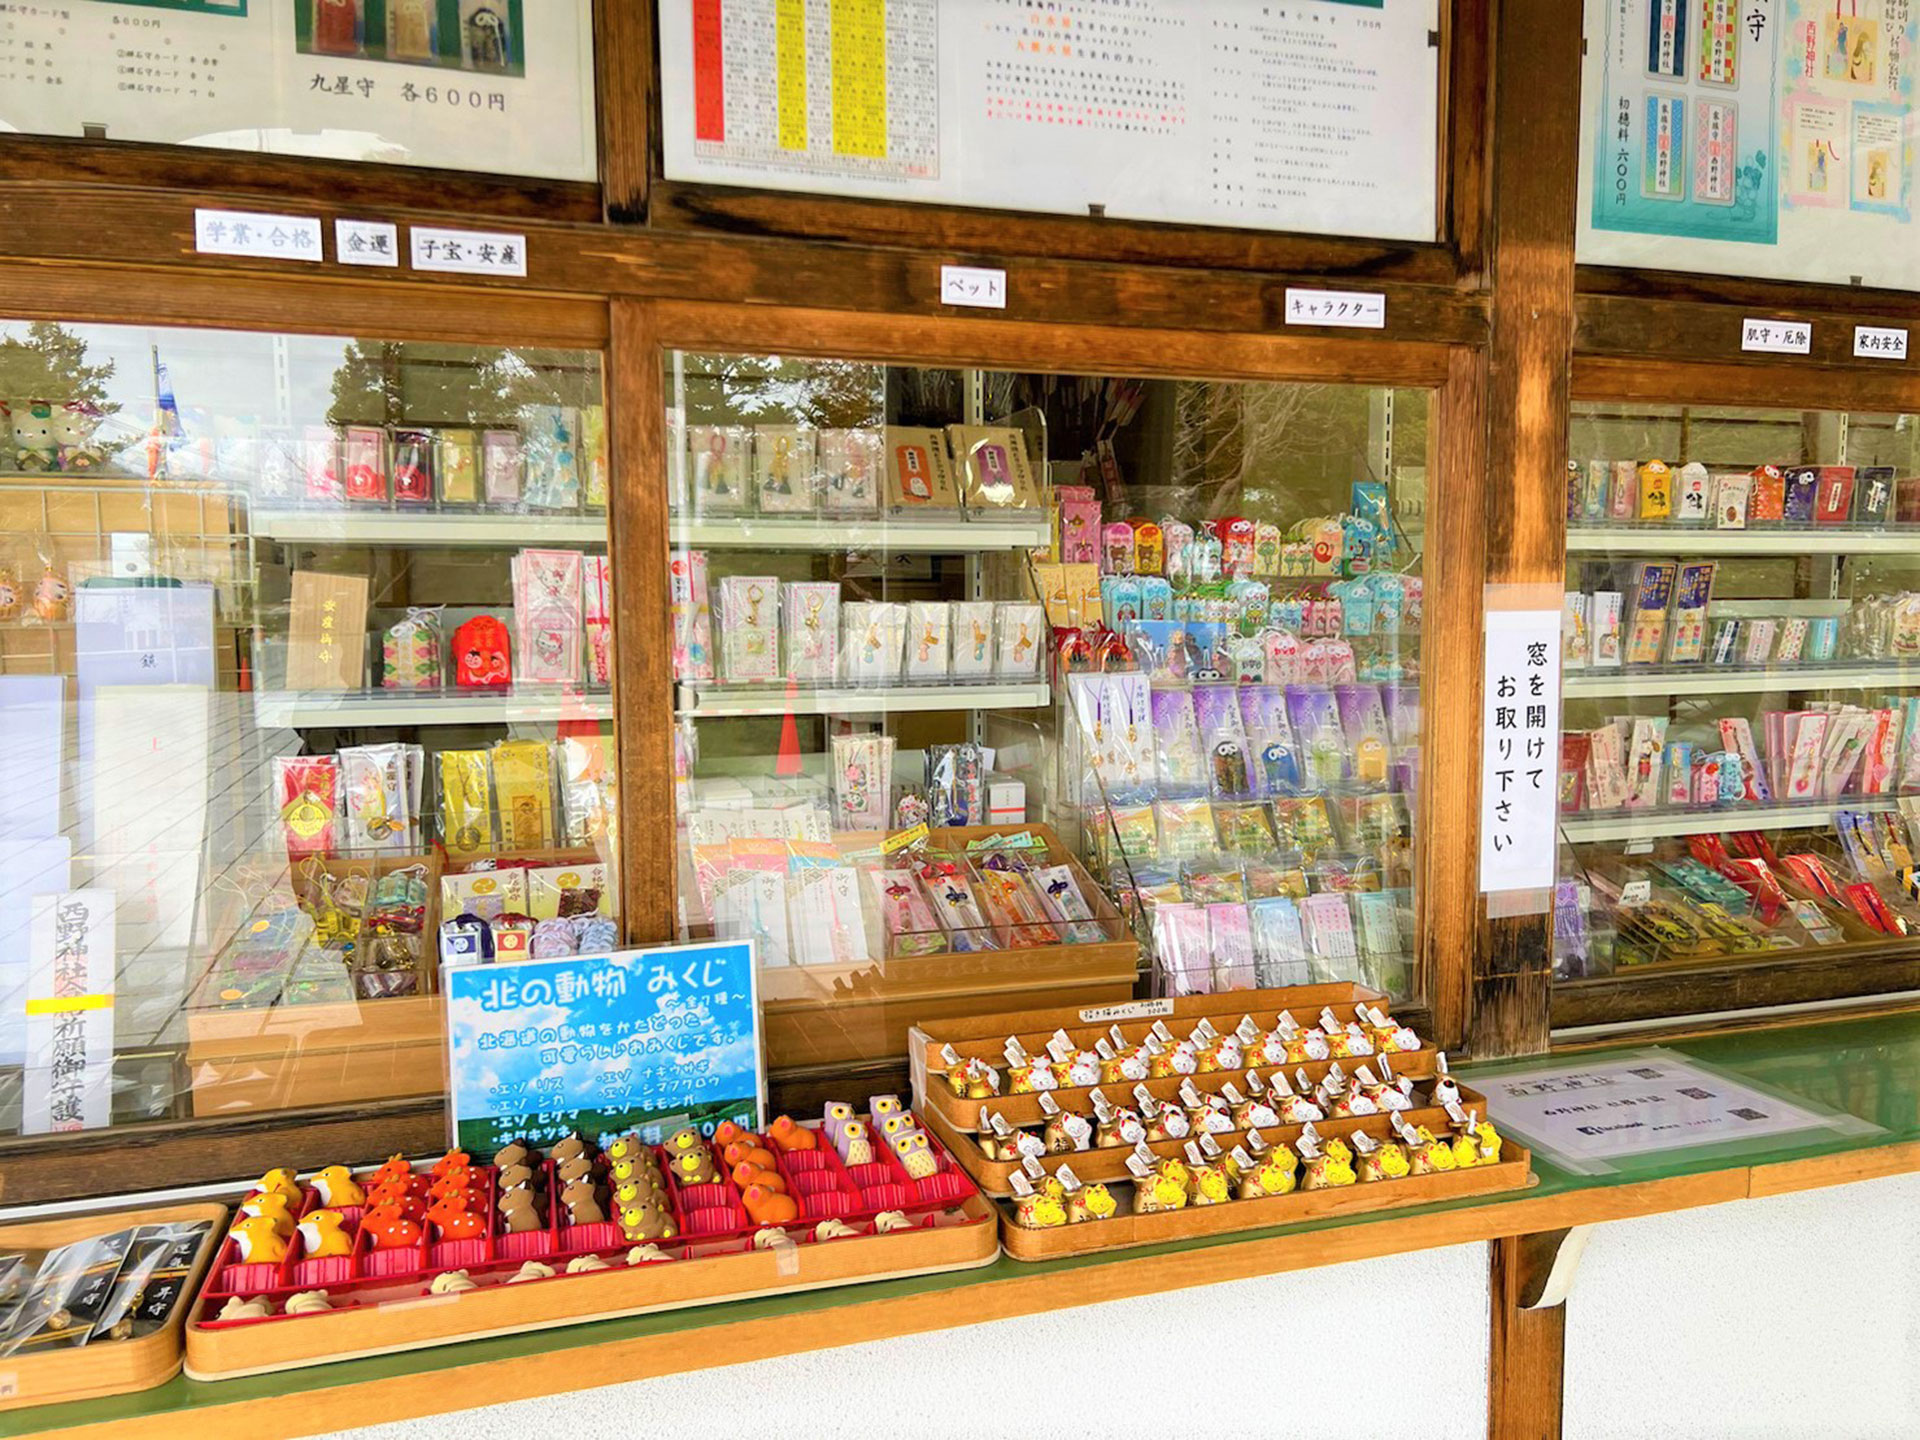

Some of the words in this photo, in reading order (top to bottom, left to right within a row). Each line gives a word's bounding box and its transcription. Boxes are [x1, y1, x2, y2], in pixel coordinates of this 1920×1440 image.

[310, 73, 375, 98] 九星守
[205, 221, 316, 249] 学業・合格
[347, 232, 392, 255] 金運
[419, 239, 518, 266] 子宝・安産
[948, 278, 999, 297] ペット
[1291, 300, 1379, 317] キャラクター
[1858, 334, 1904, 352] 家内安全
[1526, 640, 1548, 790] 窓を開けて
[1493, 674, 1517, 853] お取り下さい
[481, 965, 627, 1012] 北の動物
[647, 957, 728, 994] みくじ
[478, 1011, 702, 1050] 北海道の動物をかたどった
[540, 1031, 736, 1066] 可愛らしいおみくじです。
[643, 1076, 721, 1096] シマフクロウ
[538, 1095, 565, 1108] シカ
[643, 1094, 696, 1112] モモンガ
